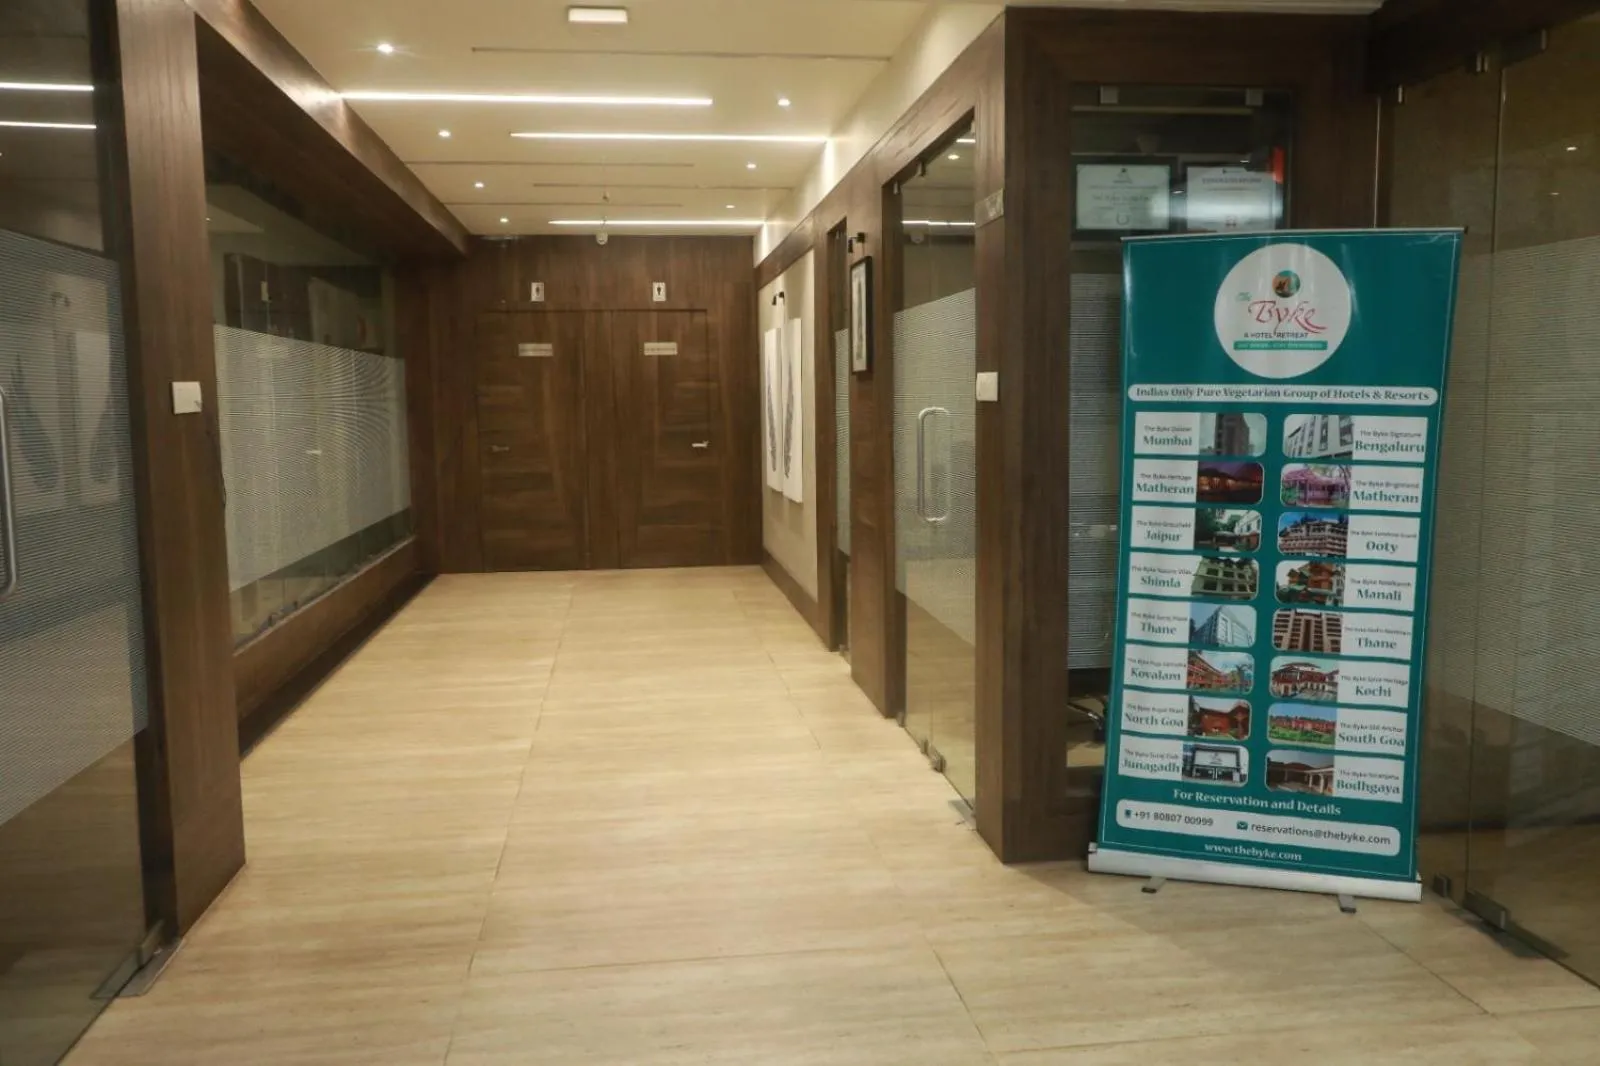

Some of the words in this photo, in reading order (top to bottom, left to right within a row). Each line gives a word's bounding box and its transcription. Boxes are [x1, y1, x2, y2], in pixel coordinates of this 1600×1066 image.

[1248, 300, 1327, 335] Byke
[1136, 387, 1169, 397] Indias
[1171, 387, 1193, 398] Only
[1197, 387, 1220, 397] Pure
[1223, 387, 1281, 399] Vegetarian
[1283, 388, 1317, 400] Group
[1319, 388, 1331, 399] of
[1333, 388, 1370, 399] Hotels
[1373, 390, 1382, 399] &
[1384, 390, 1429, 400] Resorts
[1143, 435, 1192, 446] Mumbai
[1355, 440, 1424, 453] Bengaluru
[1136, 482, 1194, 494] Matheran
[1353, 490, 1419, 503] Matheran
[1145, 530, 1181, 543] Jaipur
[1366, 540, 1398, 553] Ooty
[1140, 576, 1181, 588] Shimla
[1357, 588, 1402, 601] Manali
[1141, 622, 1177, 634] Thane
[1355, 637, 1397, 649] Thane
[1130, 667, 1181, 681] Kovalam
[1355, 685, 1391, 697] Kochi
[1125, 712, 1158, 725] North
[1161, 717, 1184, 727] Goa
[1338, 732, 1376, 744] South
[1380, 735, 1404, 746] Goa
[1122, 758, 1181, 773] Junagadh
[1336, 779, 1400, 795] Bodhgaya
[1173, 788, 1193, 800] For
[1196, 791, 1269, 808] Reservation
[1270, 798, 1294, 811] and
[1297, 800, 1342, 815] Details
[1134, 811, 1150, 820] +91
[1153, 812, 1182, 823] 80807
[1184, 815, 1214, 827] 00999
[1251, 821, 1391, 846] reservations@thebyke.com
[1204, 843, 1302, 862] www.thebyke.com
